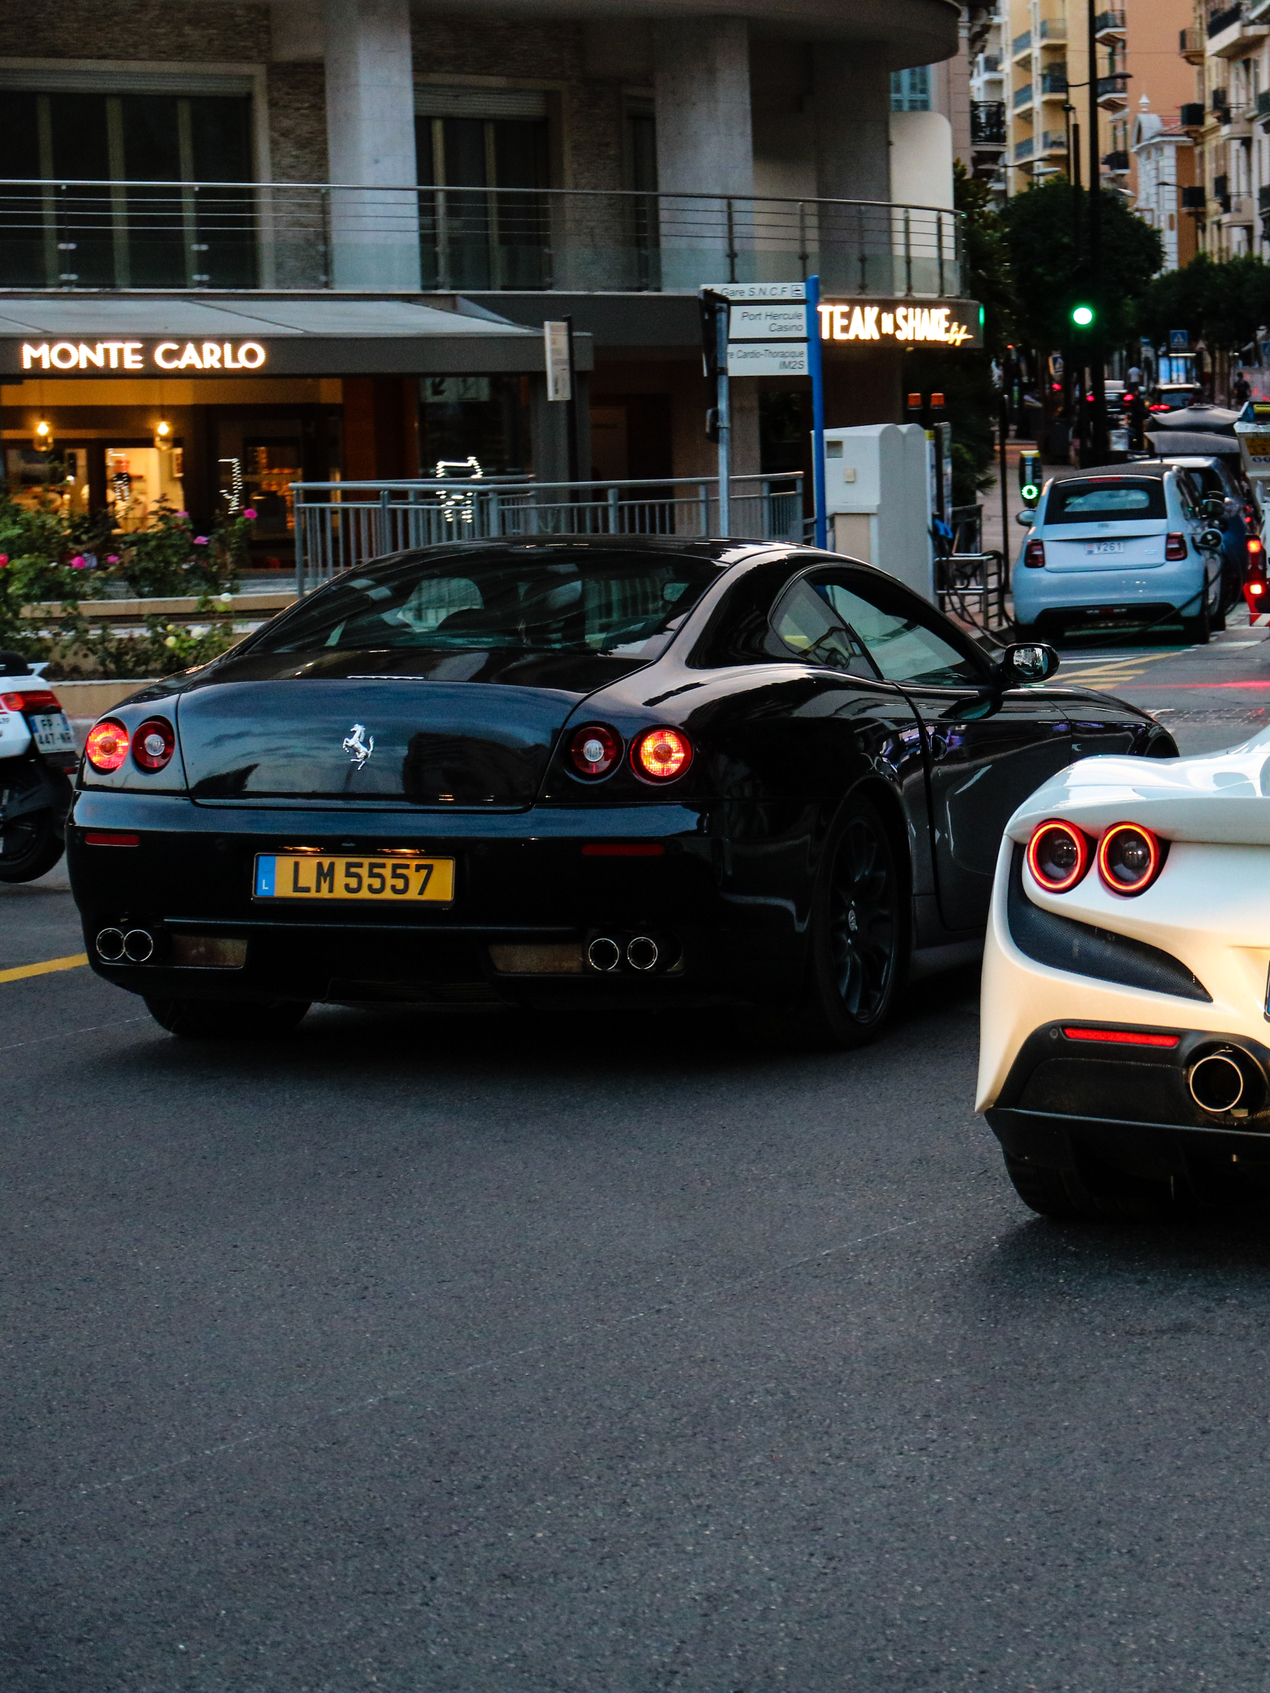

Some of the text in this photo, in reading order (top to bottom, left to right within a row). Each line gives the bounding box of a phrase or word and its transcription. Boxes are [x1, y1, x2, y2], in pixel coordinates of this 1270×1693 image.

[720, 287, 745, 297] Gare
[741, 311, 803, 320] Port Hercule
[768, 322, 804, 332] Casino
[895, 306, 951, 341] SHAKE
[22, 342, 267, 370] MONTE CARLO
[779, 360, 805, 370] IM2S
[262, 879, 269, 890] L
